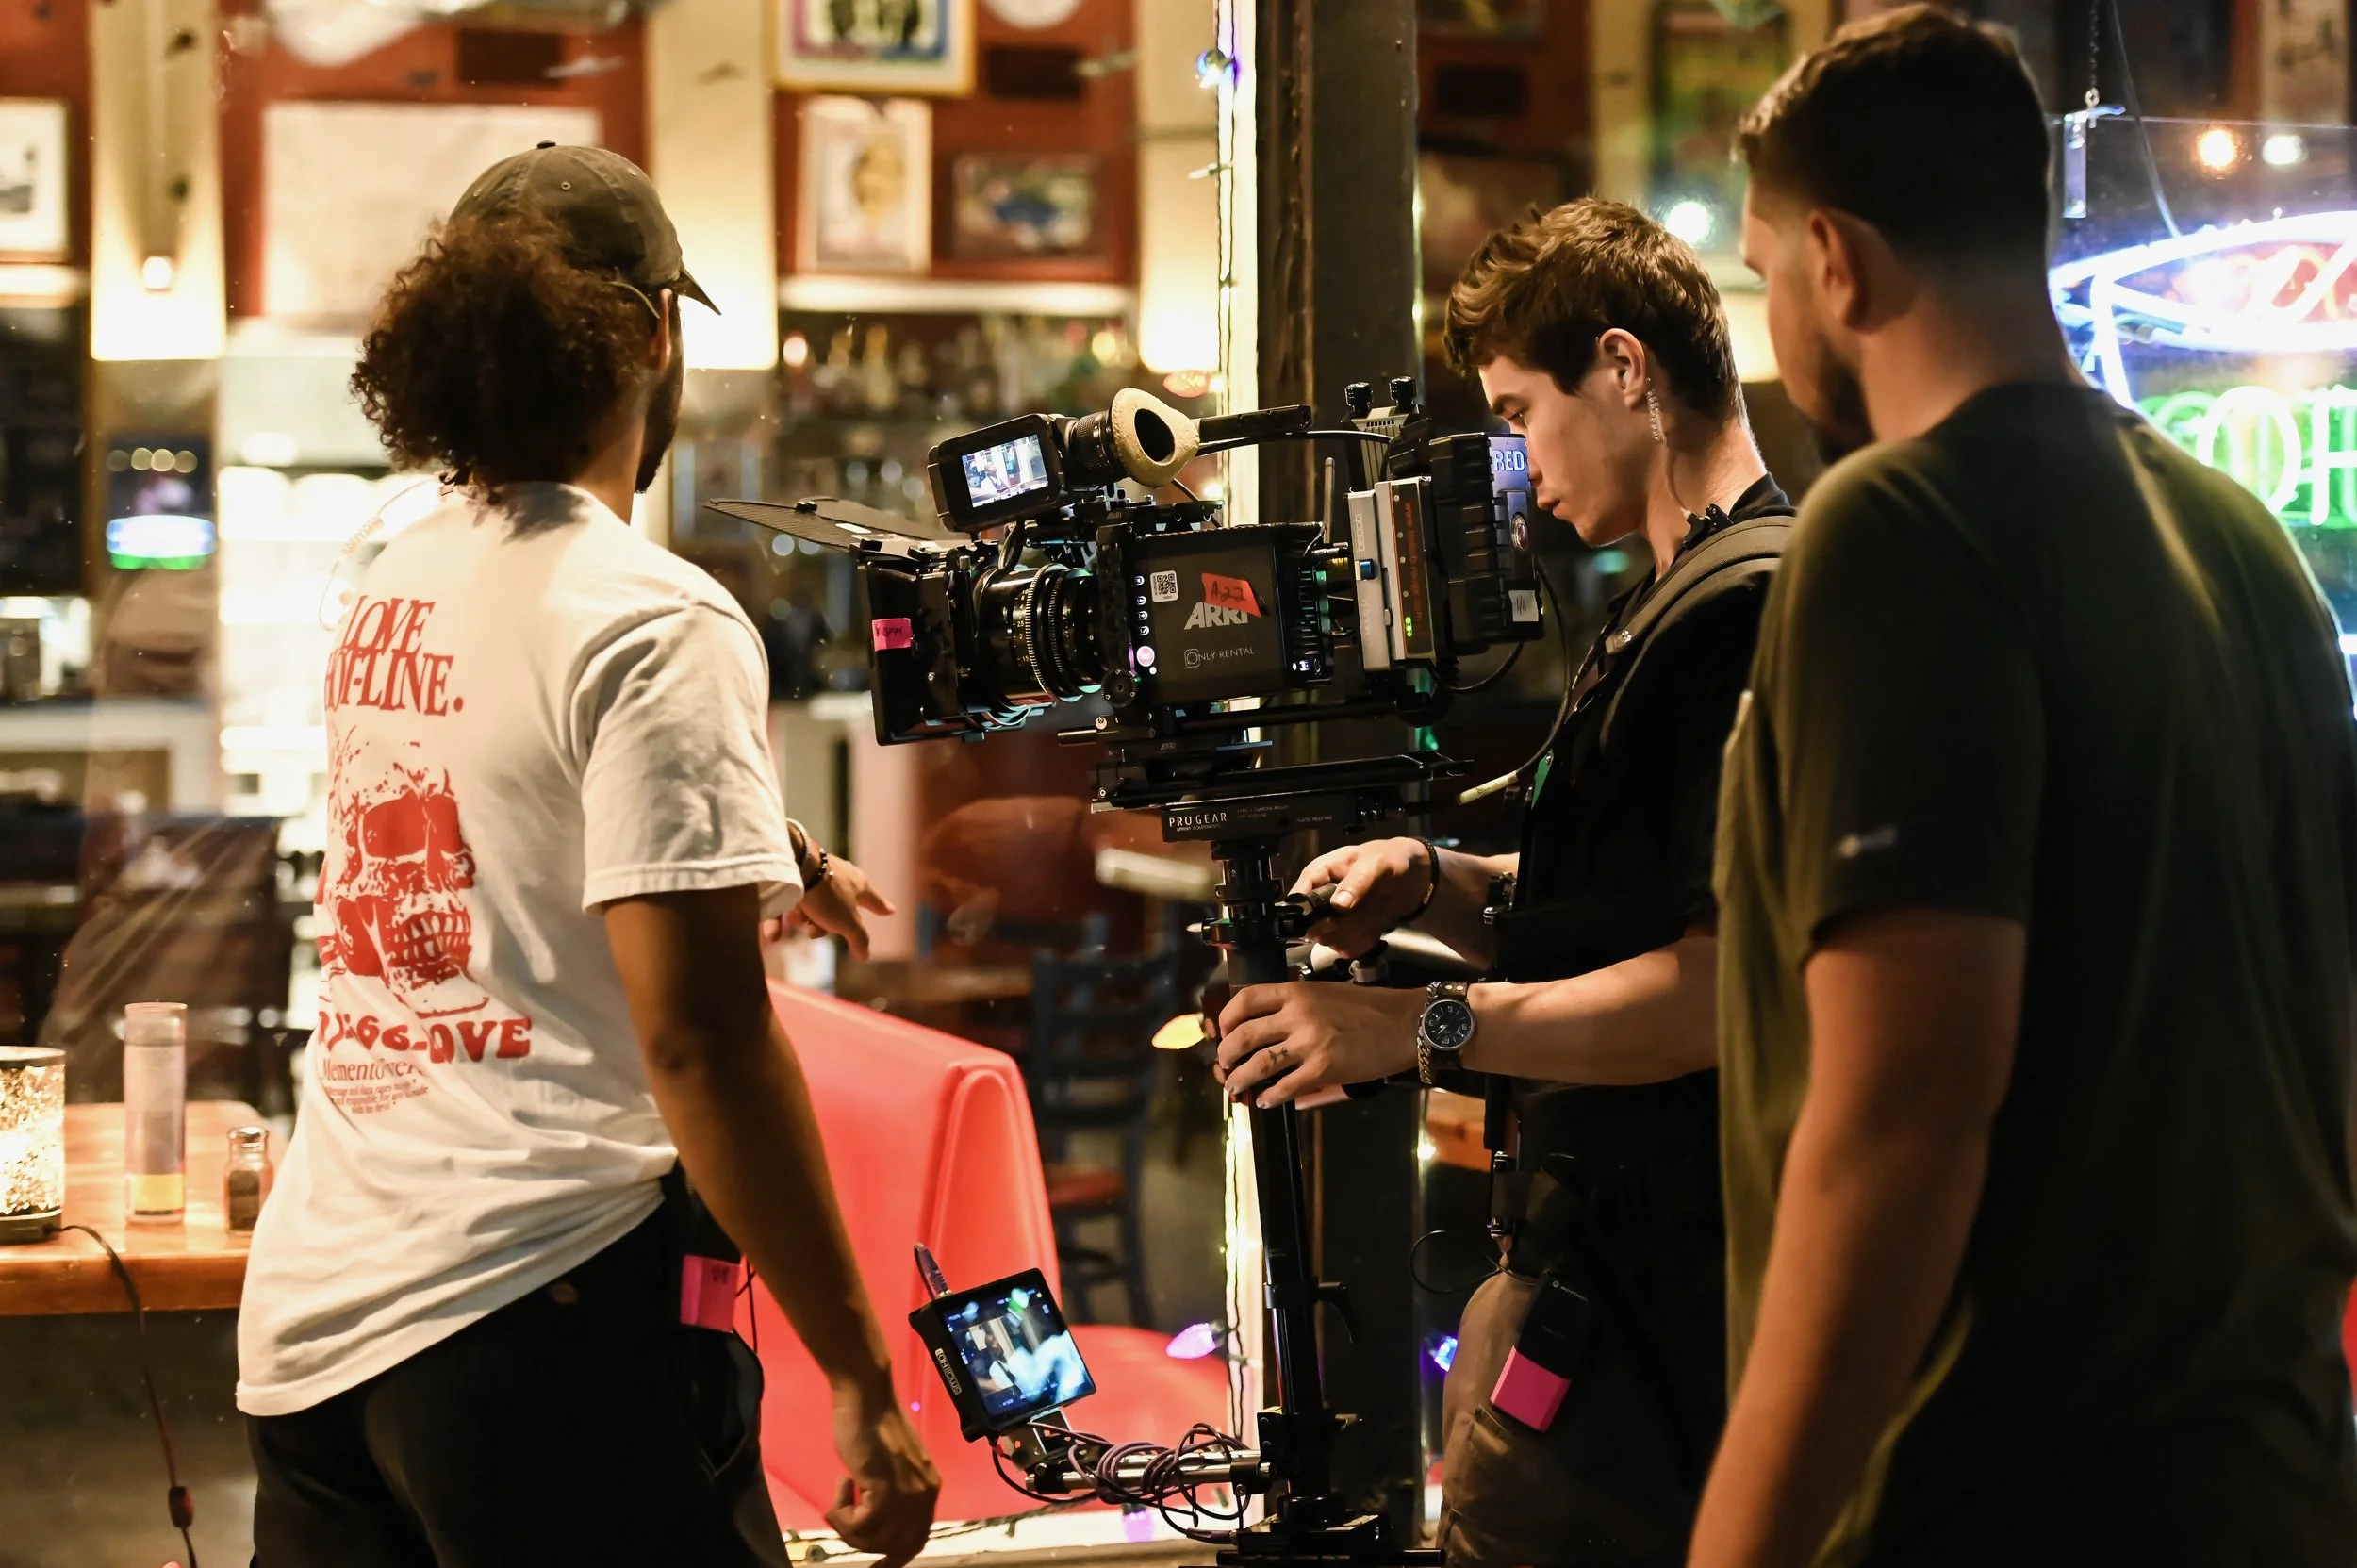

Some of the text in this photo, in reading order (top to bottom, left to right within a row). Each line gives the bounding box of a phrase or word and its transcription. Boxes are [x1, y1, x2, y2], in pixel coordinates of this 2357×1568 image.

[1492, 450, 1525, 471] RED
[340, 595, 436, 656] LOVE
[1219, 646, 1255, 659] RENTAL
[1169, 816, 1192, 828] PRO
[1195, 812, 1227, 824] GEAR
